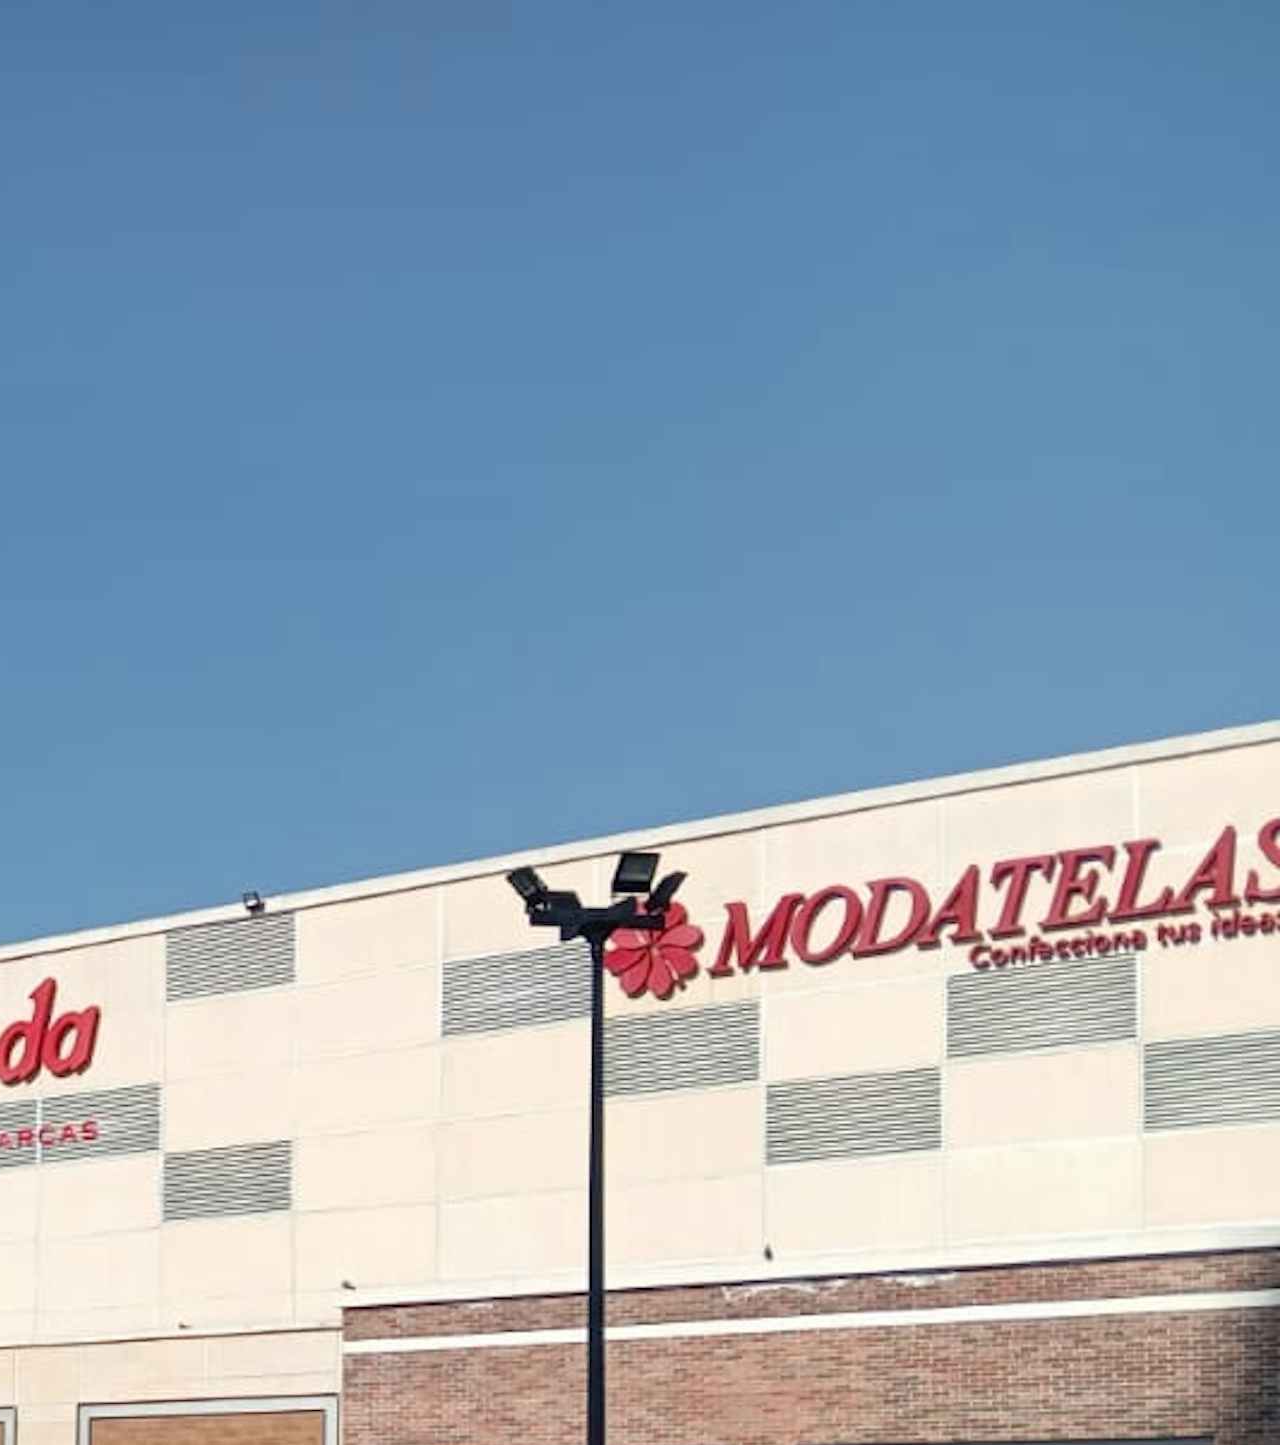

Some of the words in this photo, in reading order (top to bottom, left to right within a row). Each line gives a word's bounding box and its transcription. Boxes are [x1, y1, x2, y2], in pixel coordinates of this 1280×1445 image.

[707, 818, 1280, 978] MODATELAS
[968, 928, 1148, 971] Confecciona
[1156, 921, 1203, 948] tus
[1209, 905, 1280, 942] idea
